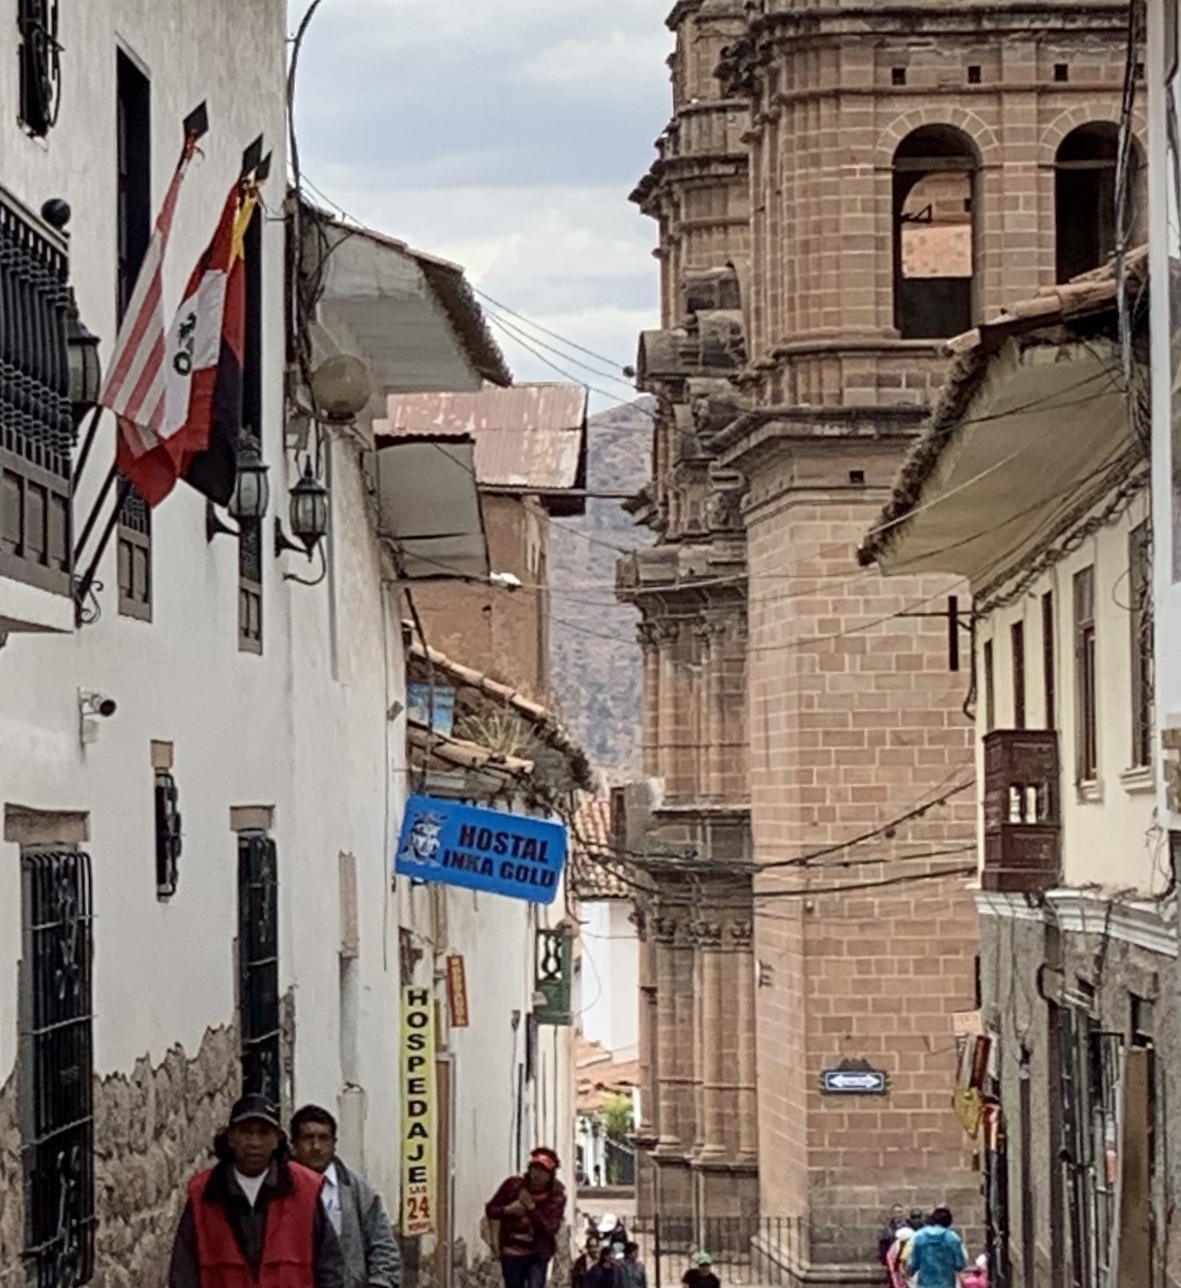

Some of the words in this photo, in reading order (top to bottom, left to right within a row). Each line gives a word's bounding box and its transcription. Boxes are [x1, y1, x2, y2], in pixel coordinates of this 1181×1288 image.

[459, 823, 549, 864] HOSTAL
[442, 849, 494, 877] INKA
[499, 860, 556, 888] GOLD
[406, 989, 429, 1184] HOSPEDAJE
[407, 1196, 430, 1219] 24
